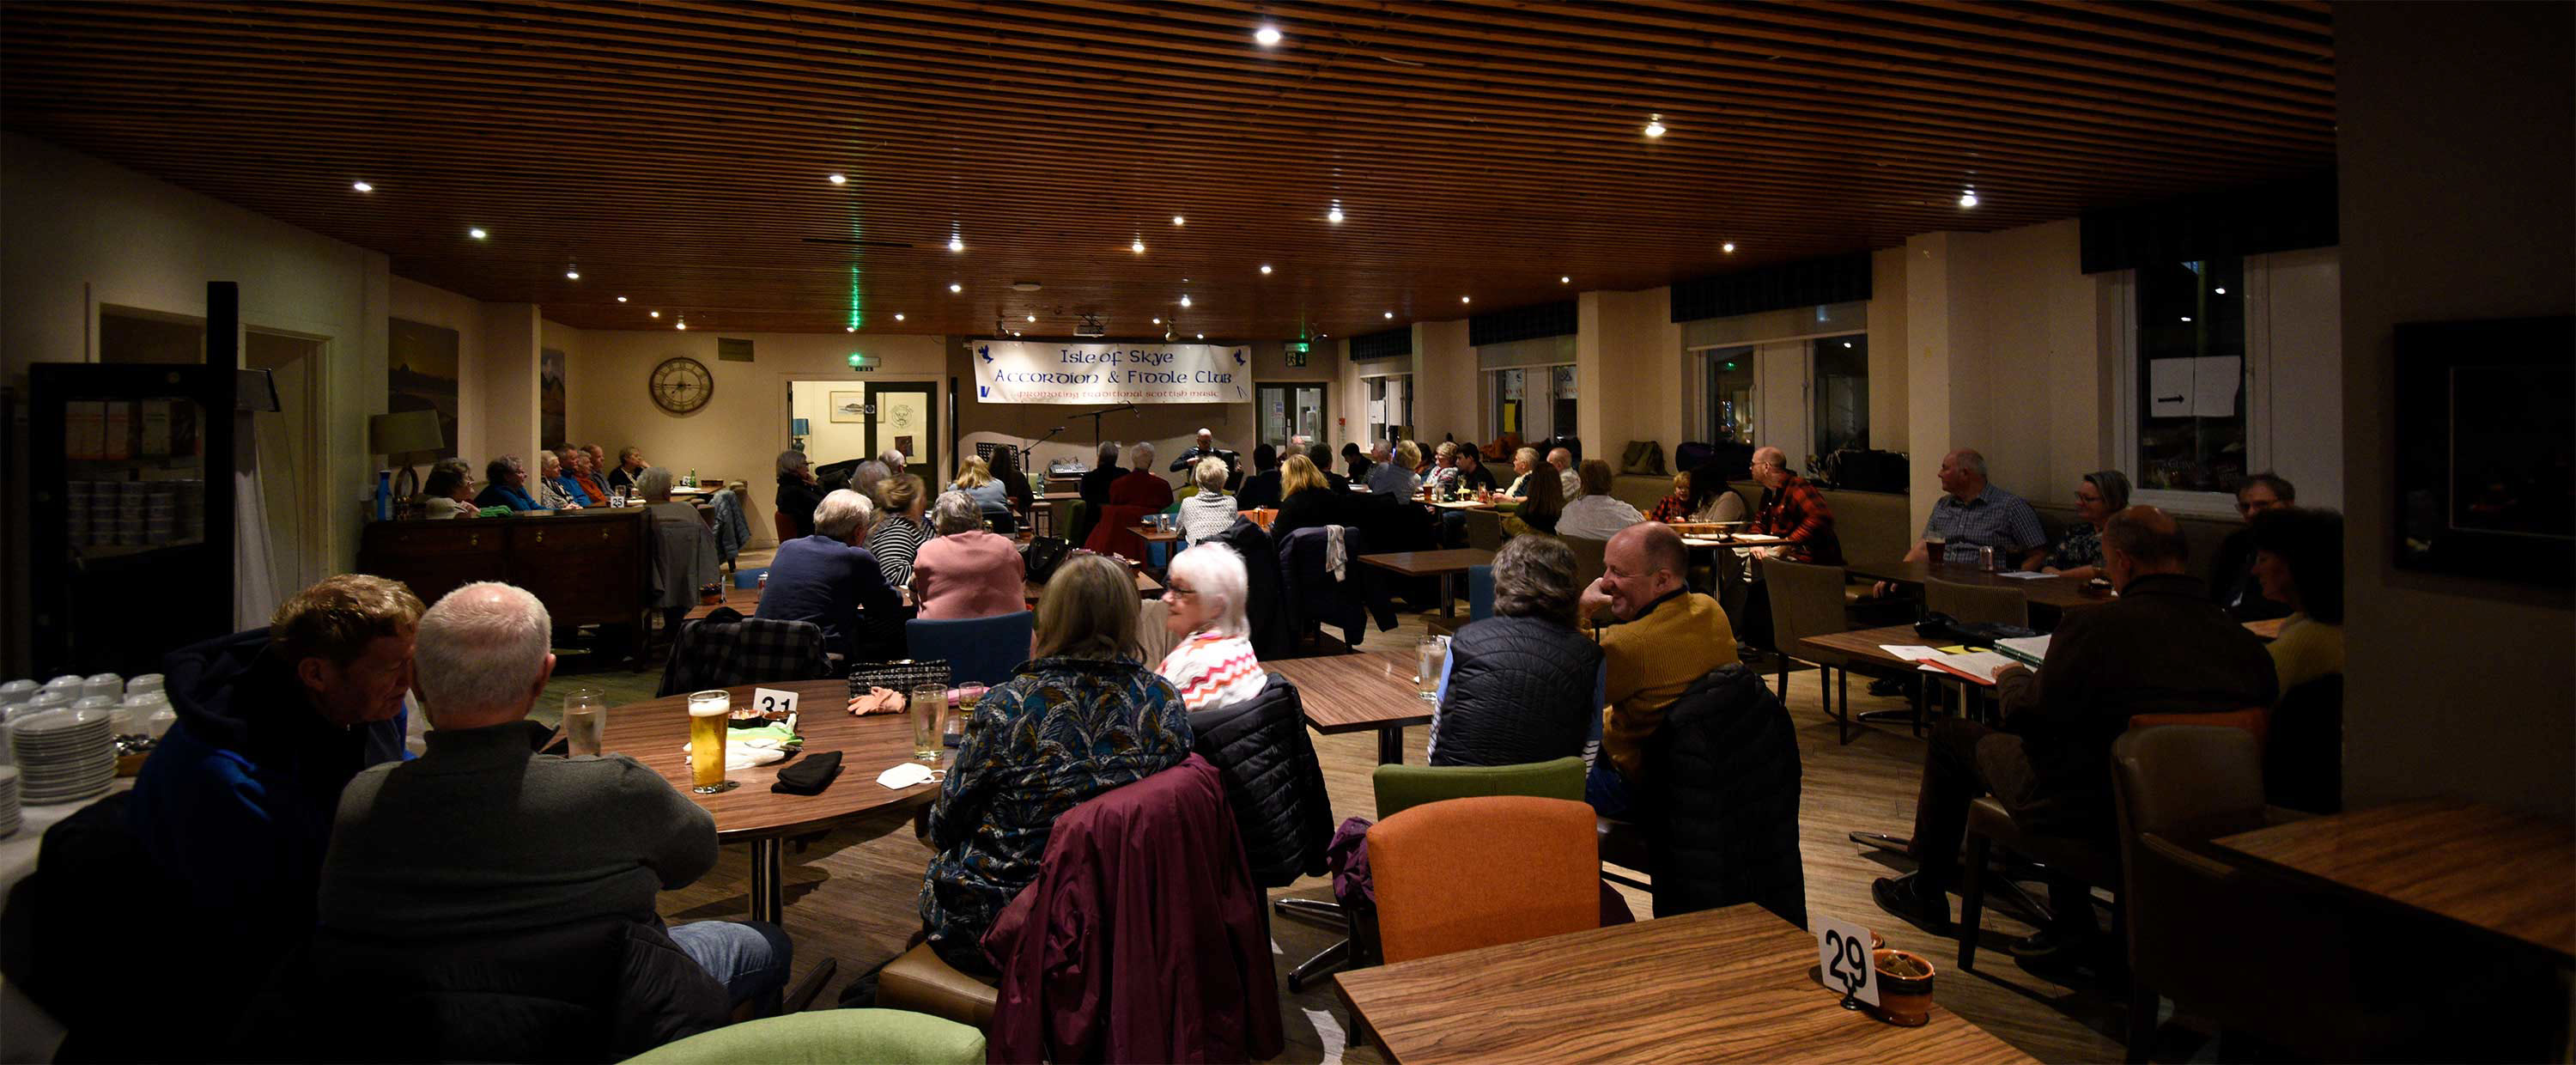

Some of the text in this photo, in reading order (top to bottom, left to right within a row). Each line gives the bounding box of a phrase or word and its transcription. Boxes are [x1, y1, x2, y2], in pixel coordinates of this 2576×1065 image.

[1060, 350, 1175, 367] Isle of Skye
[1108, 370, 1120, 383] &
[1127, 370, 1188, 384] Fiddle
[612, 498, 623, 507] 25
[1826, 929, 1867, 989] 29
